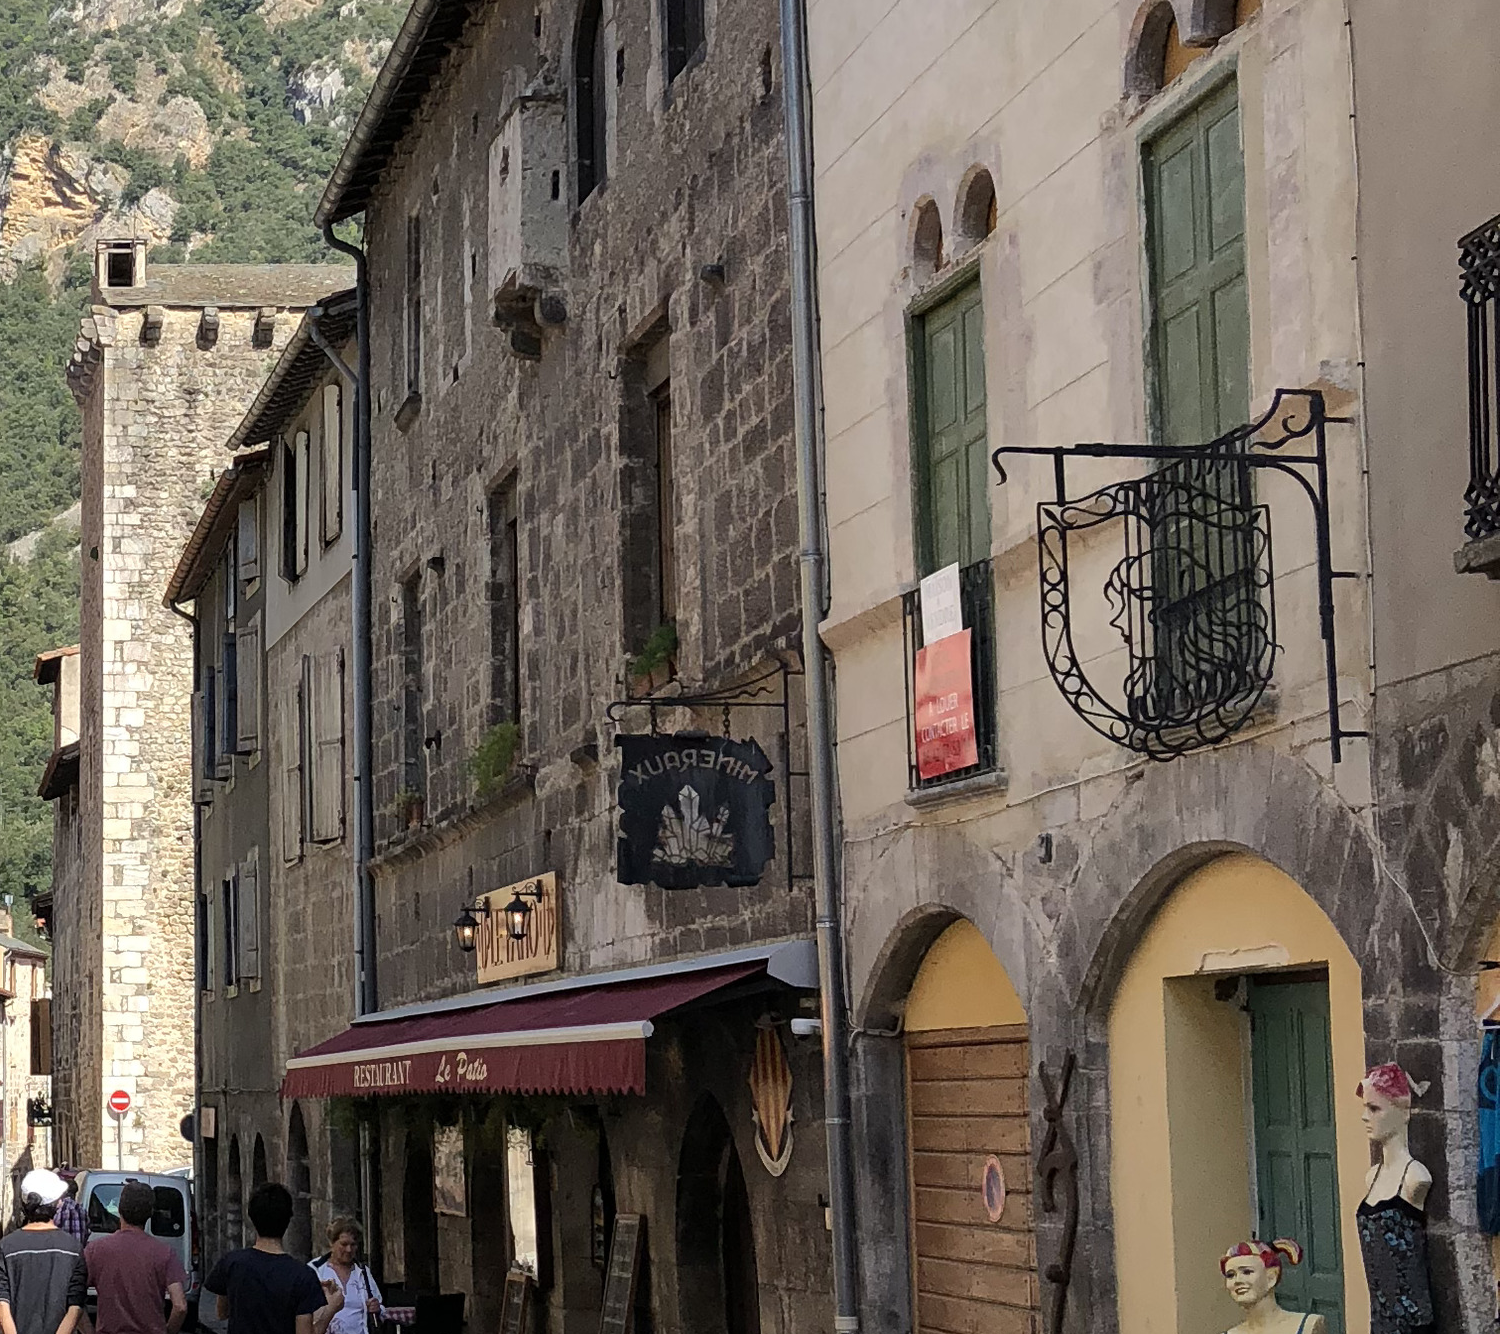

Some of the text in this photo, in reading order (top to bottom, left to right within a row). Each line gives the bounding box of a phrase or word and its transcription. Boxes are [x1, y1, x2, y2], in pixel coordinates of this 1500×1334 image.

[353, 1051, 488, 1088] RESTAURANT Le Patio
